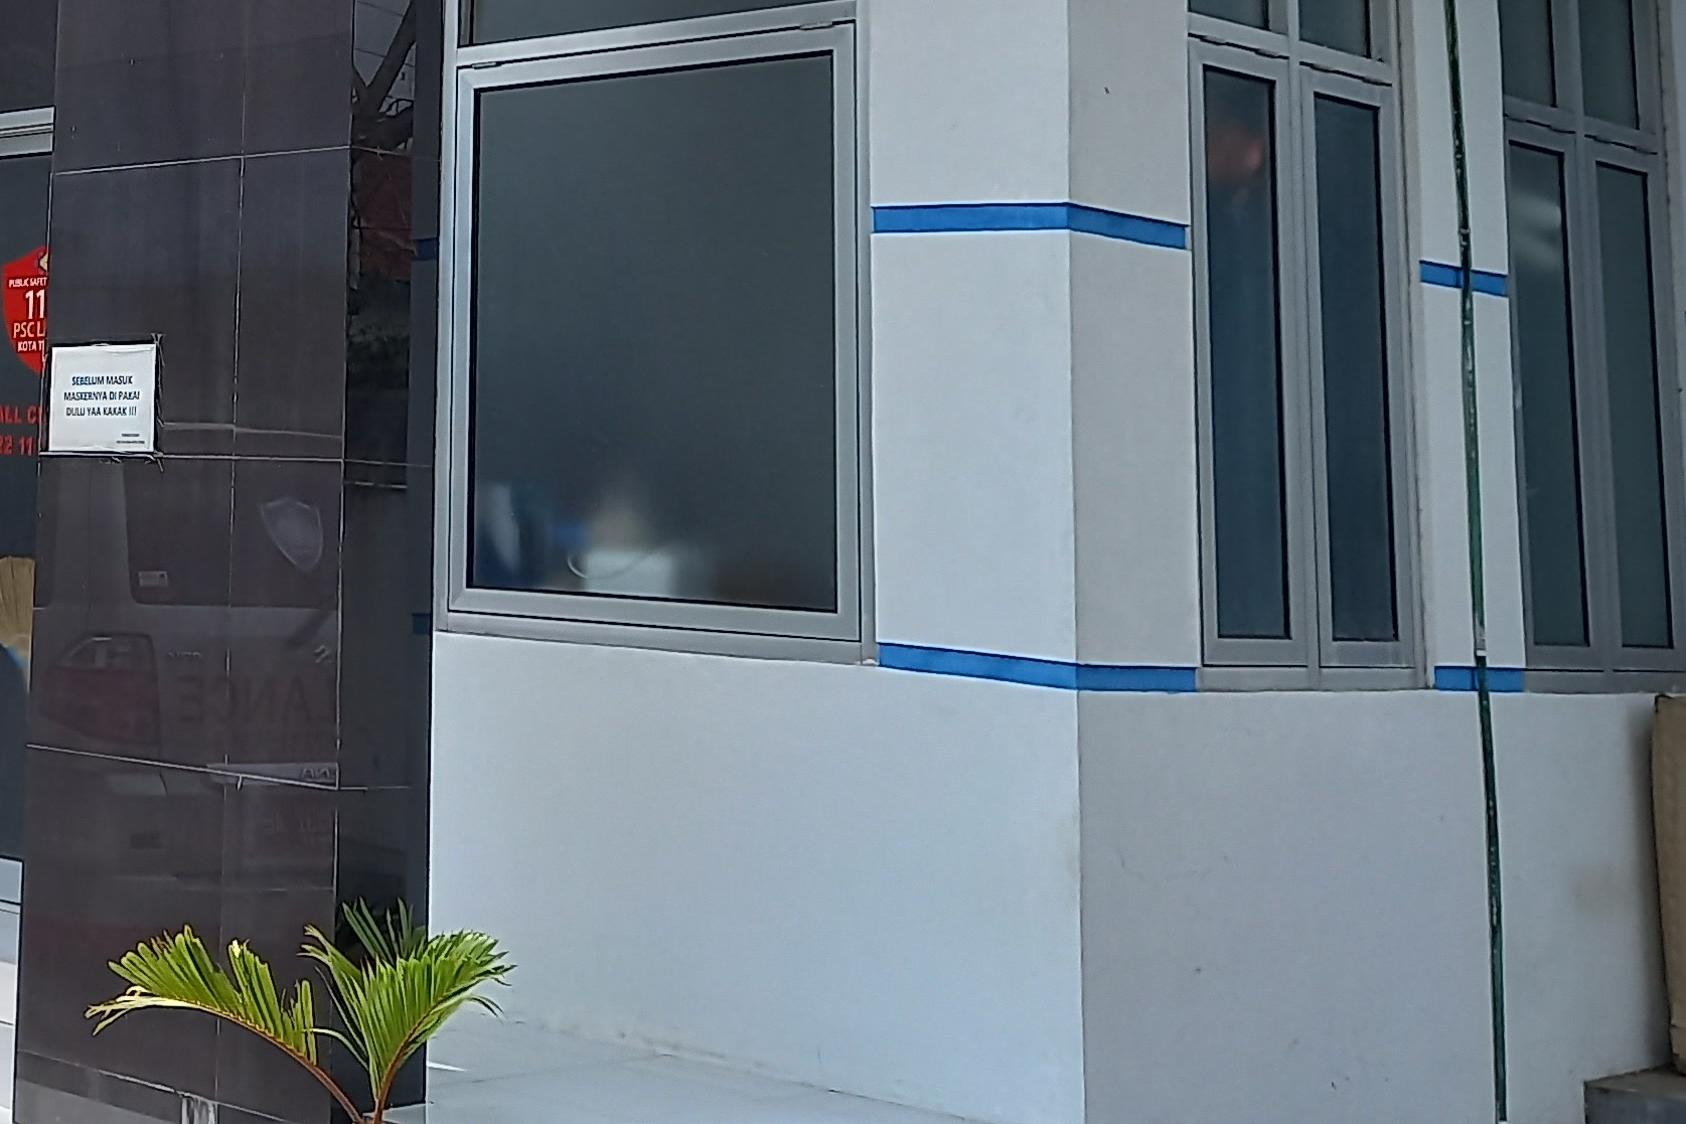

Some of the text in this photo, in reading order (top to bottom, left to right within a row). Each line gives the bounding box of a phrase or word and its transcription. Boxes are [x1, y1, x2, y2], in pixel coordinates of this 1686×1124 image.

[30, 276, 47, 287] SAFET
[25, 289, 45, 320] 11
[13, 320, 46, 339] PSC L
[17, 340, 37, 353] KOTA
[71, 375, 133, 386] SEBELUM MASUK
[63, 390, 140, 401] MASKERNYA DI PAKAI
[66, 407, 85, 416] DULU
[87, 406, 101, 416] YAA
[103, 406, 127, 416] KAKAK
[20, 436, 34, 456] 11
